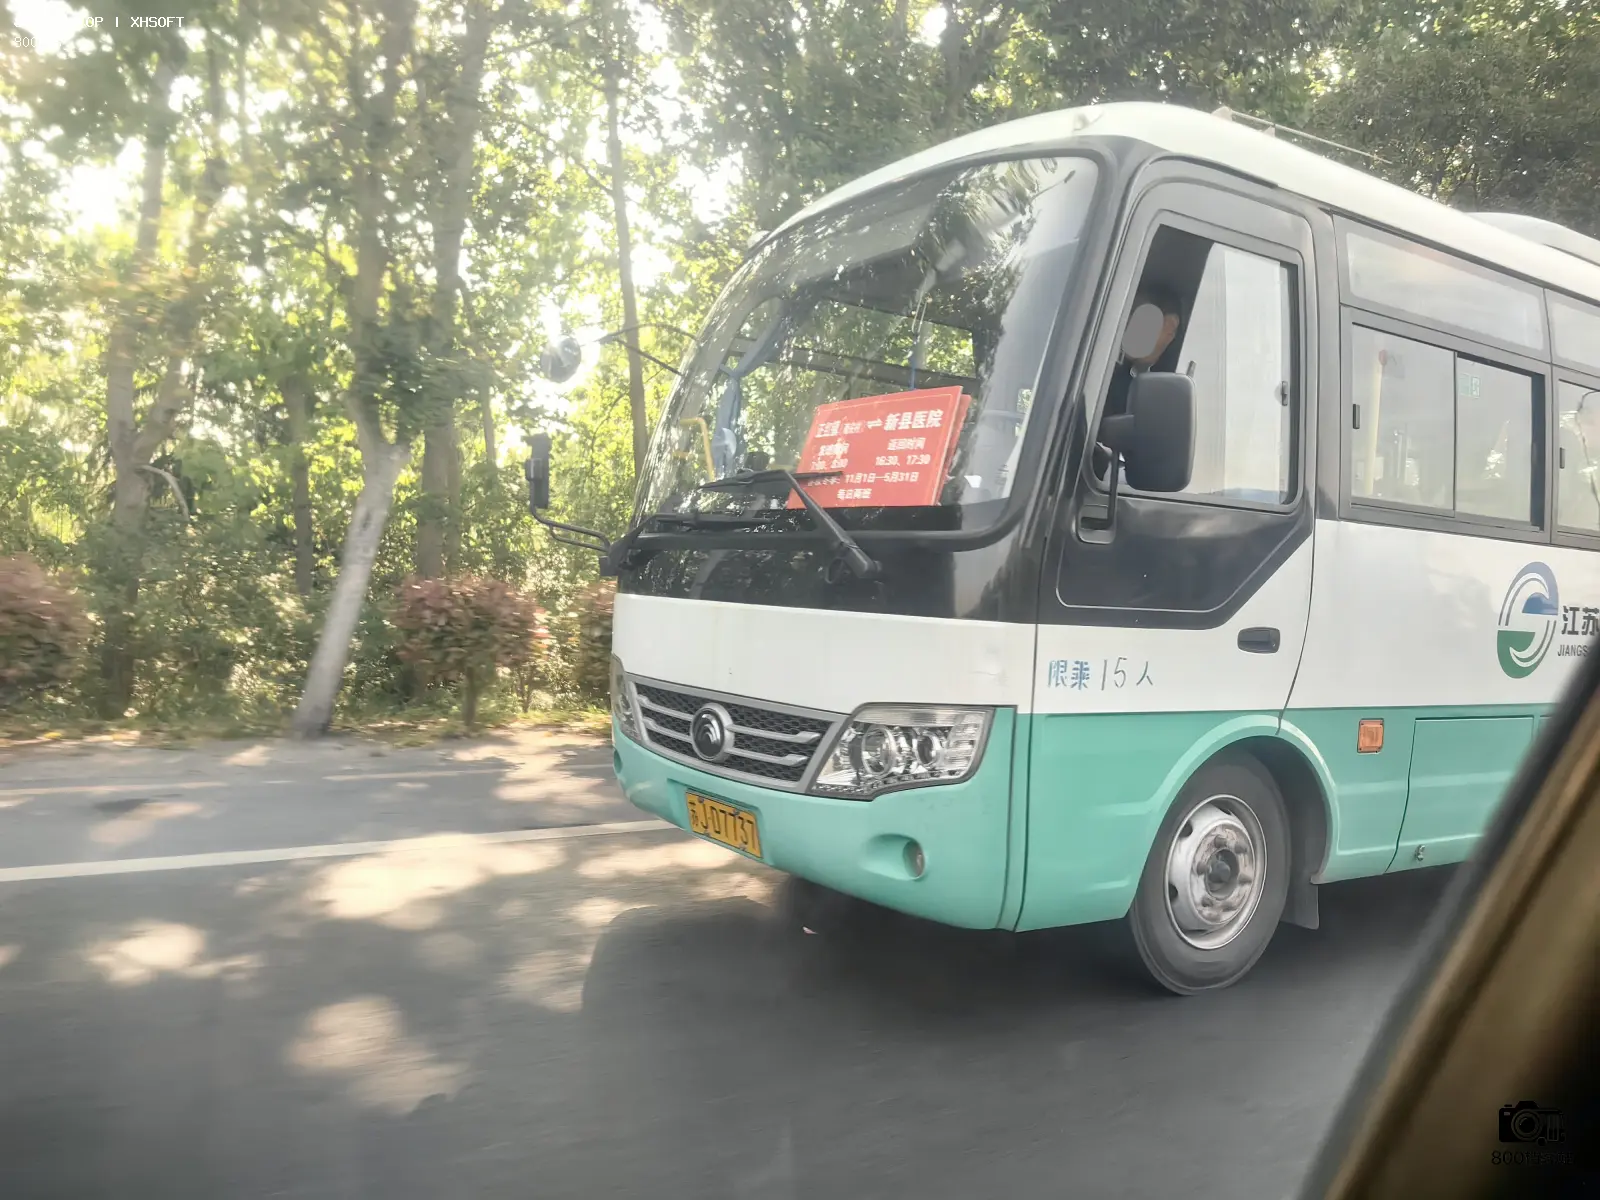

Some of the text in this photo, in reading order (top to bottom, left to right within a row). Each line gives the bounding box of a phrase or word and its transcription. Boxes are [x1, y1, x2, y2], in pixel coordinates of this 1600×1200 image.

[884, 409, 944, 431] 新县医院
[1561, 605, 1600, 636] 江苏
